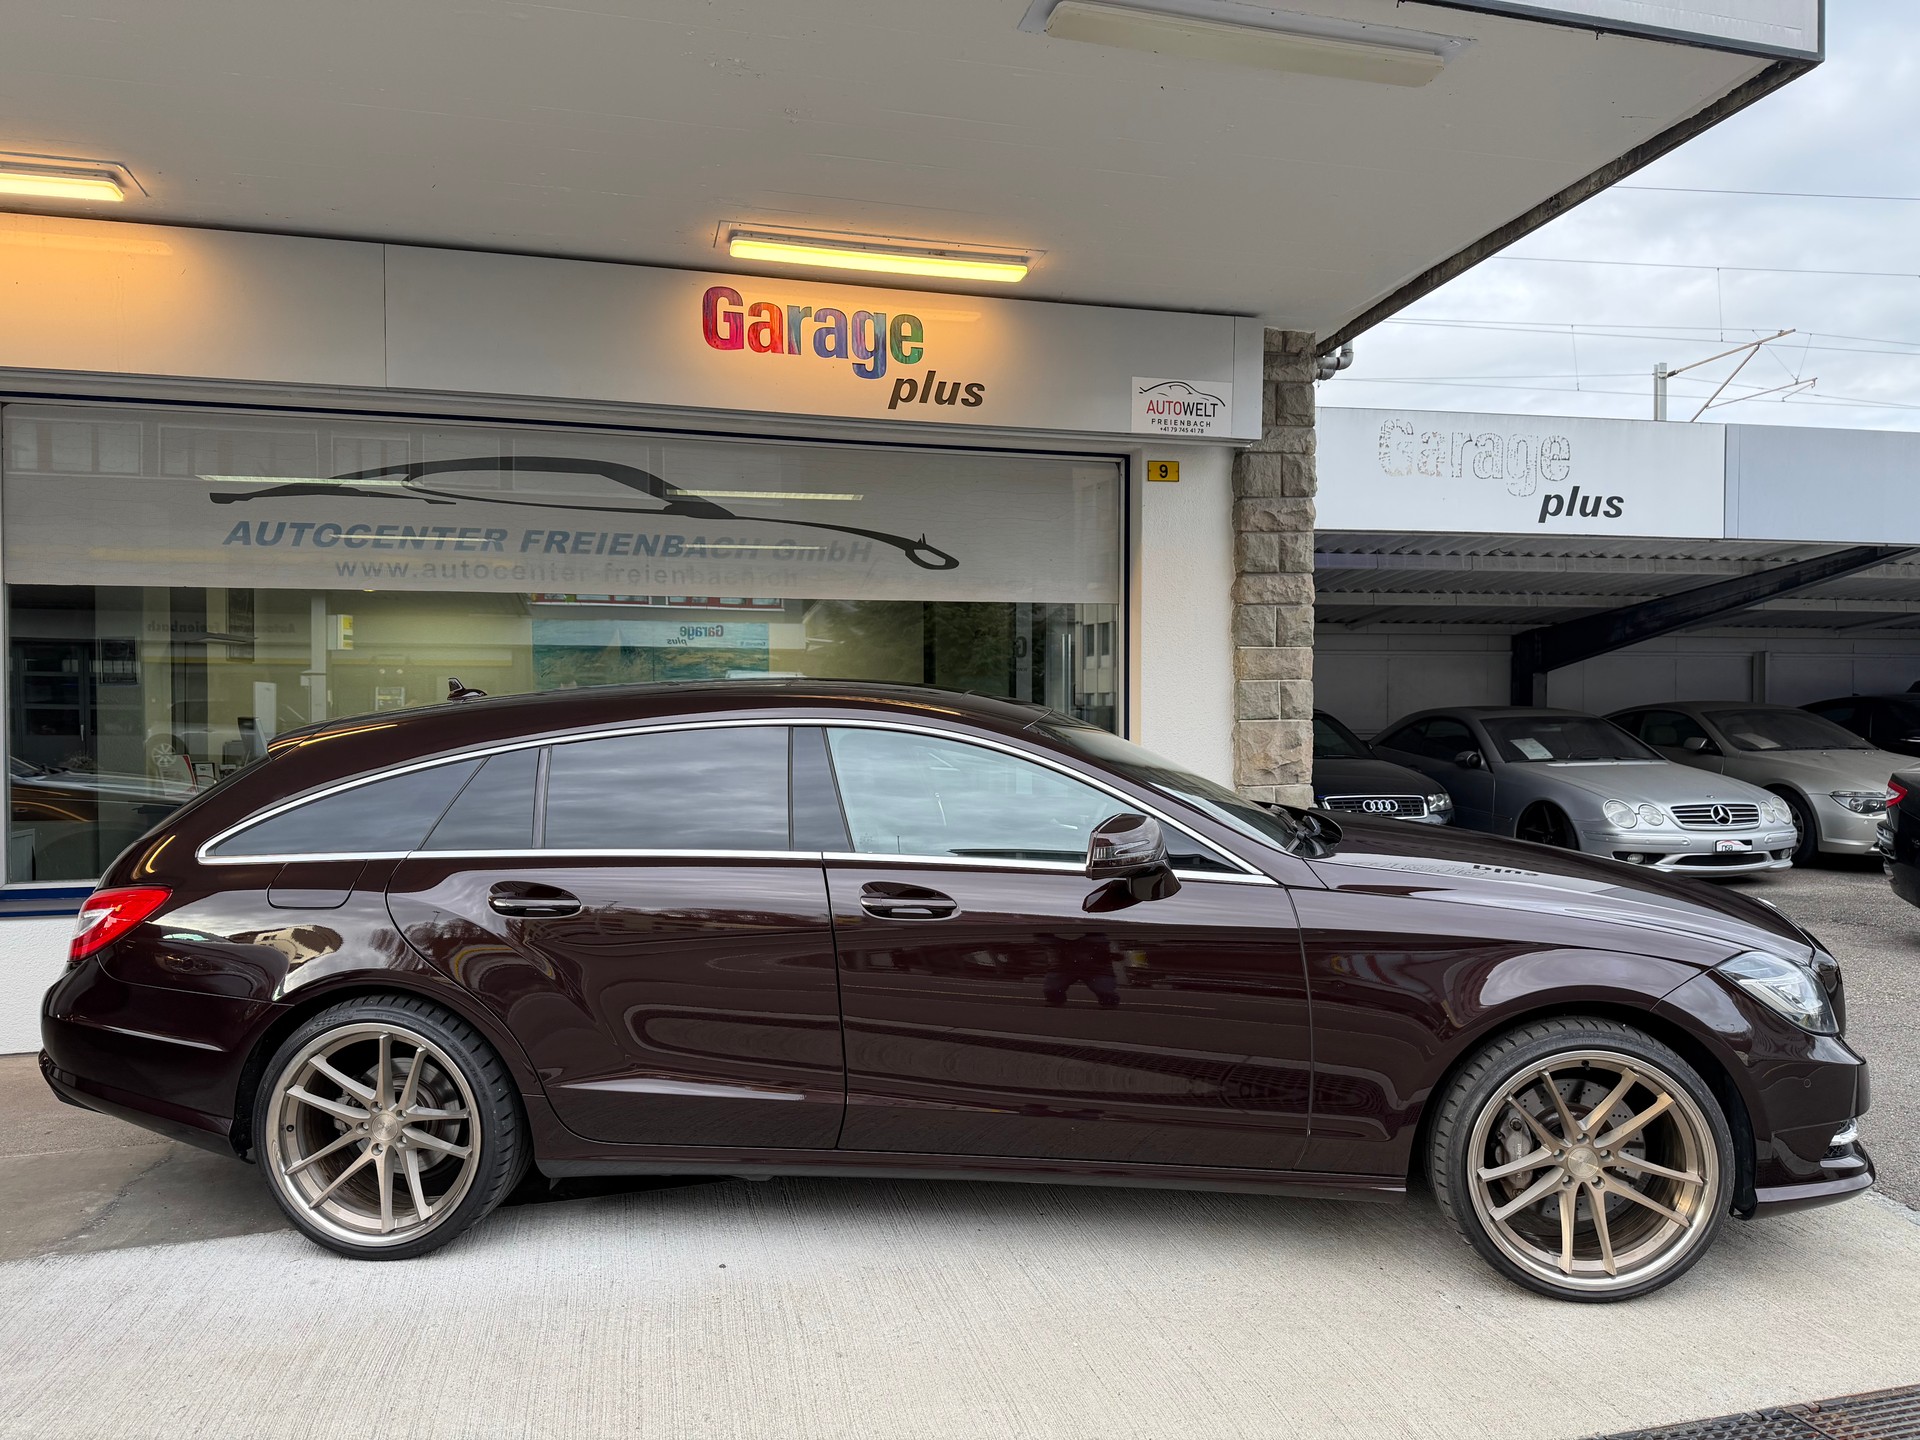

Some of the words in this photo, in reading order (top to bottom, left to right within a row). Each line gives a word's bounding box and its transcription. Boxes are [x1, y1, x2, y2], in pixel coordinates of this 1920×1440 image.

[702, 286, 924, 380] Garage
[887, 370, 986, 410] plus
[1146, 399, 1218, 418] AUTOWELT
[1151, 418, 1211, 427] FREIENBACH
[1159, 464, 1168, 479] 9
[1378, 418, 1571, 498] Garage
[1538, 485, 1625, 524] plus
[222, 520, 507, 552] AUTOCENTER
[520, 528, 762, 561] FREIENBACH
[772, 539, 873, 562] GmbH
